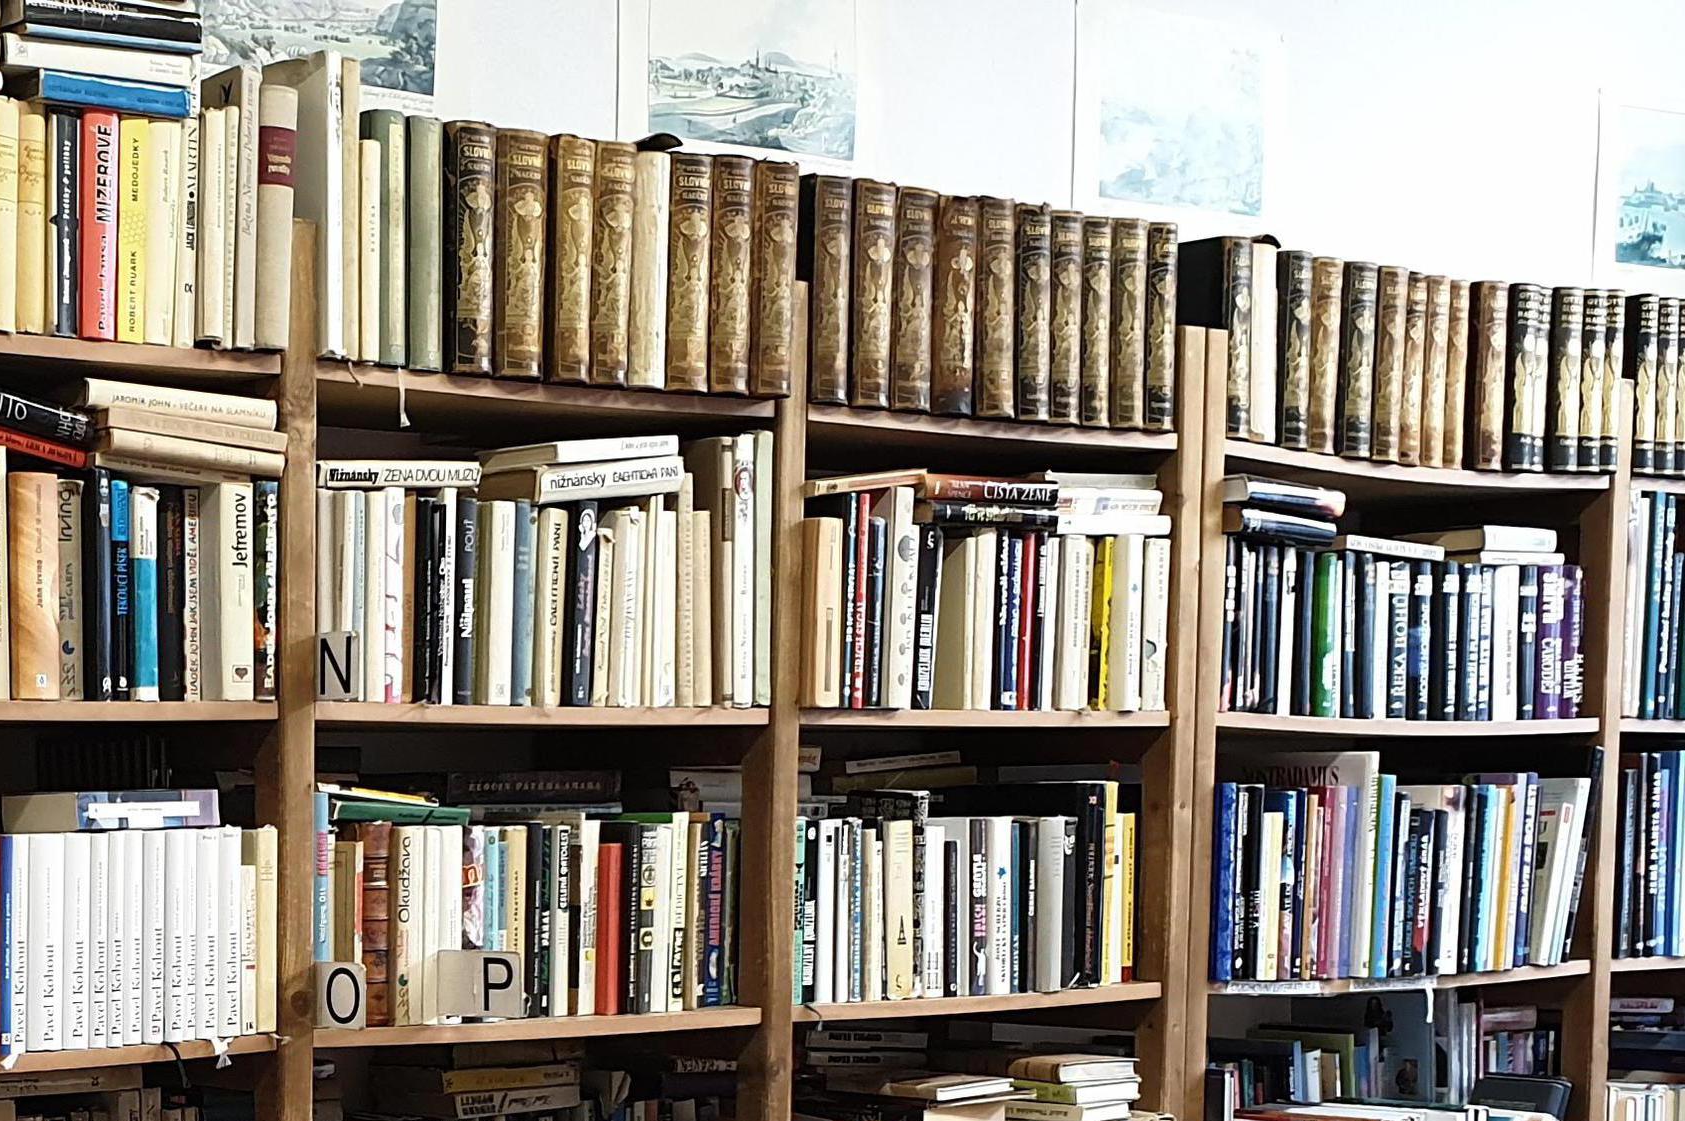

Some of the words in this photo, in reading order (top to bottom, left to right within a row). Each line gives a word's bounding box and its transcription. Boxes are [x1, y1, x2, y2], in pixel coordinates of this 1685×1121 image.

[57, 489, 74, 543] Irving
[231, 493, 250, 569] Jefremov
[115, 546, 128, 573] PÍSEK
[319, 635, 352, 696] N
[397, 835, 412, 924] Okudžava
[14, 940, 25, 994] Kohout
[43, 944, 54, 997] Kohout
[72, 941, 84, 994] Kohout
[94, 940, 105, 994] Kohout
[110, 939, 122, 993] Kohout
[151, 927, 163, 984] Kohout
[171, 935, 182, 992] Kohout
[204, 935, 215, 990] Kohout
[225, 932, 237, 987] Kohout
[151, 988, 162, 1021] Pavel
[226, 990, 237, 1026] Pavel
[325, 967, 360, 1025] O
[482, 956, 514, 1012] P
[14, 1005, 25, 1044] Pavel
[44, 1005, 54, 1042] Pavel
[73, 1001, 83, 1038] Pavel
[94, 1000, 105, 1037] Pavel
[111, 998, 121, 1035] Pavel
[171, 996, 182, 1030] Pavel
[205, 994, 216, 1029] Pavel
